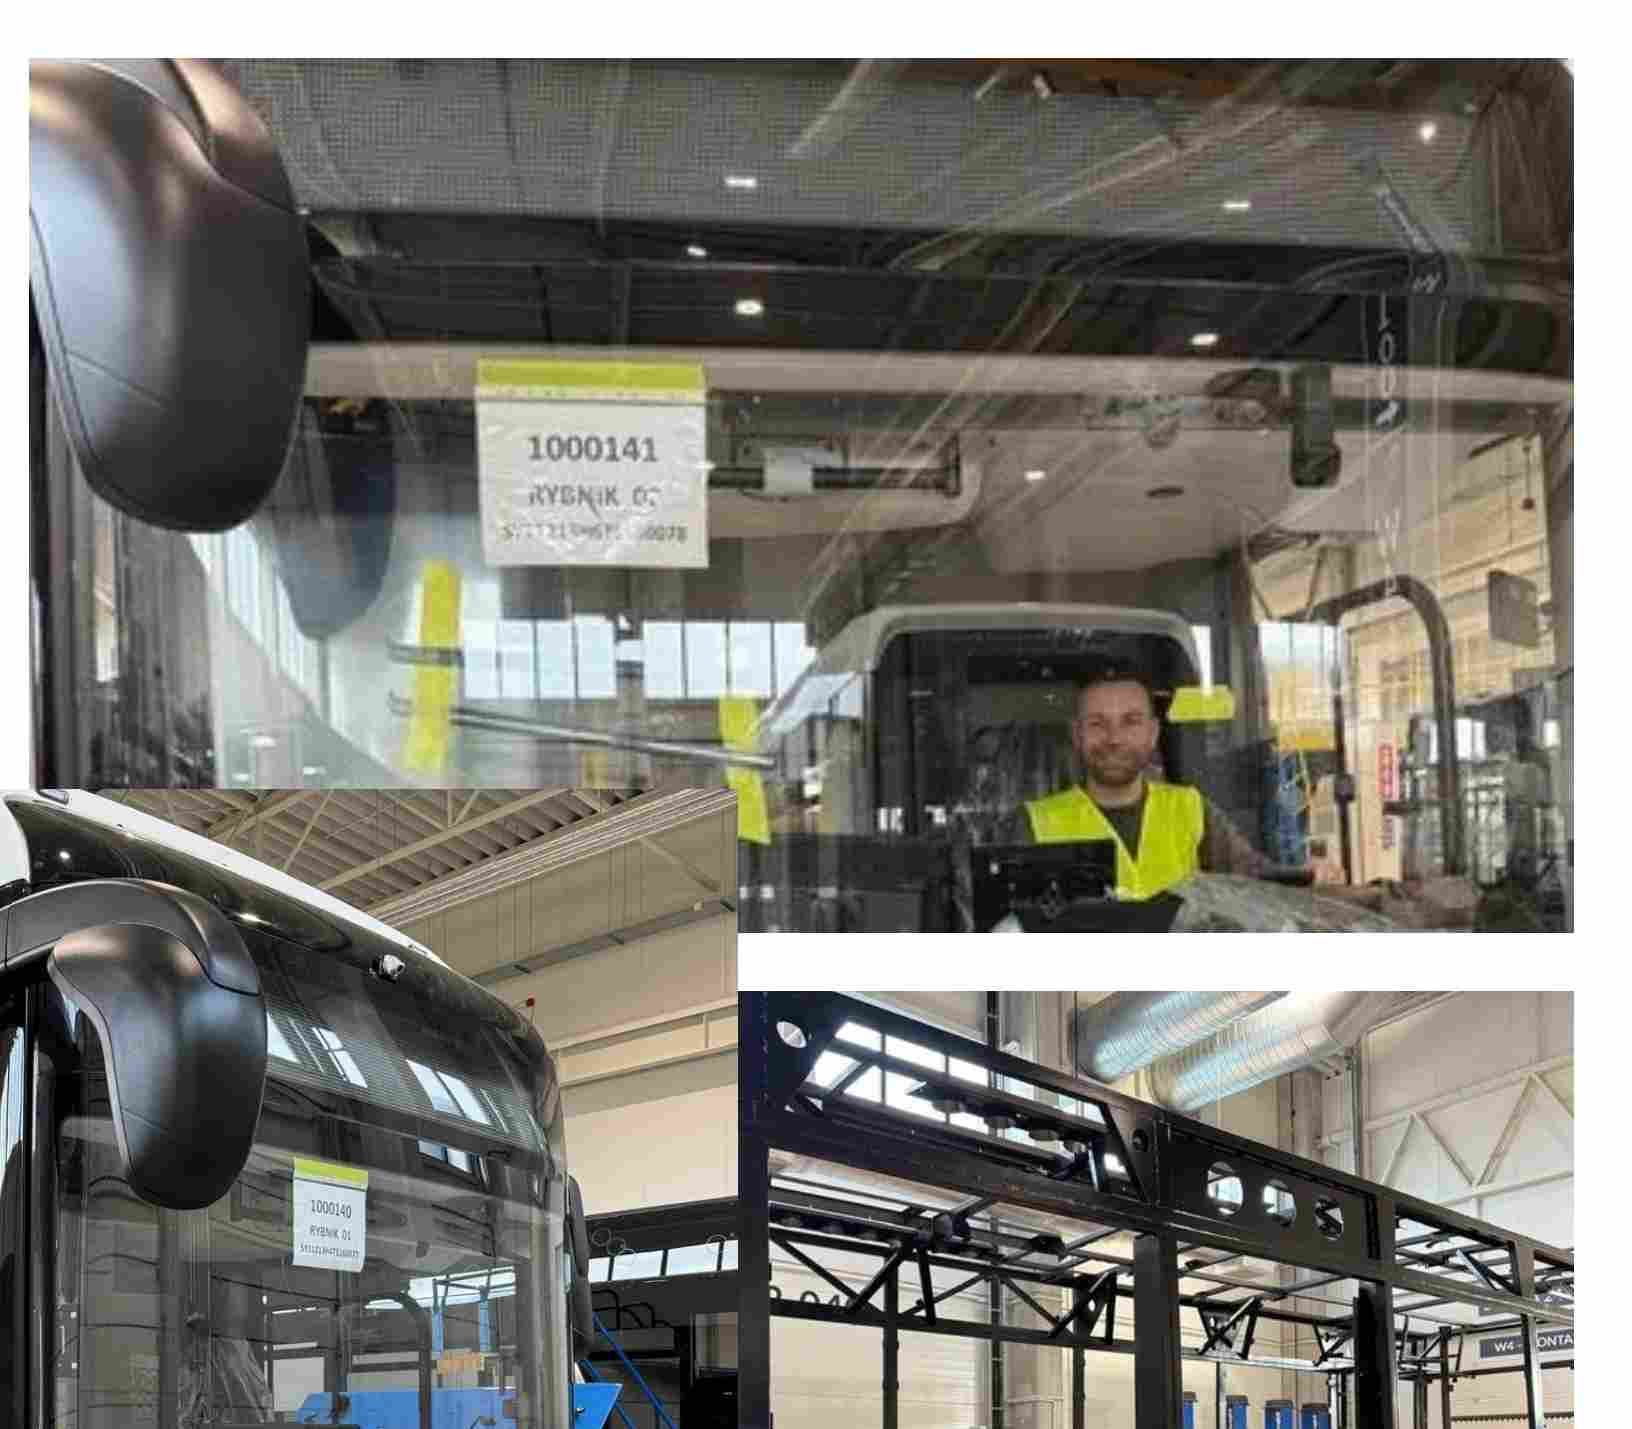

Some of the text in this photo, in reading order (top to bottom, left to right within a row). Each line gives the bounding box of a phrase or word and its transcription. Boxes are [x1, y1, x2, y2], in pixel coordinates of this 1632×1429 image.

[528, 435, 659, 462] 1000141
[311, 1199, 352, 1219] 1000140
[1494, 1341, 1514, 1353] W4
[1535, 1334, 1575, 1348] ONTA
